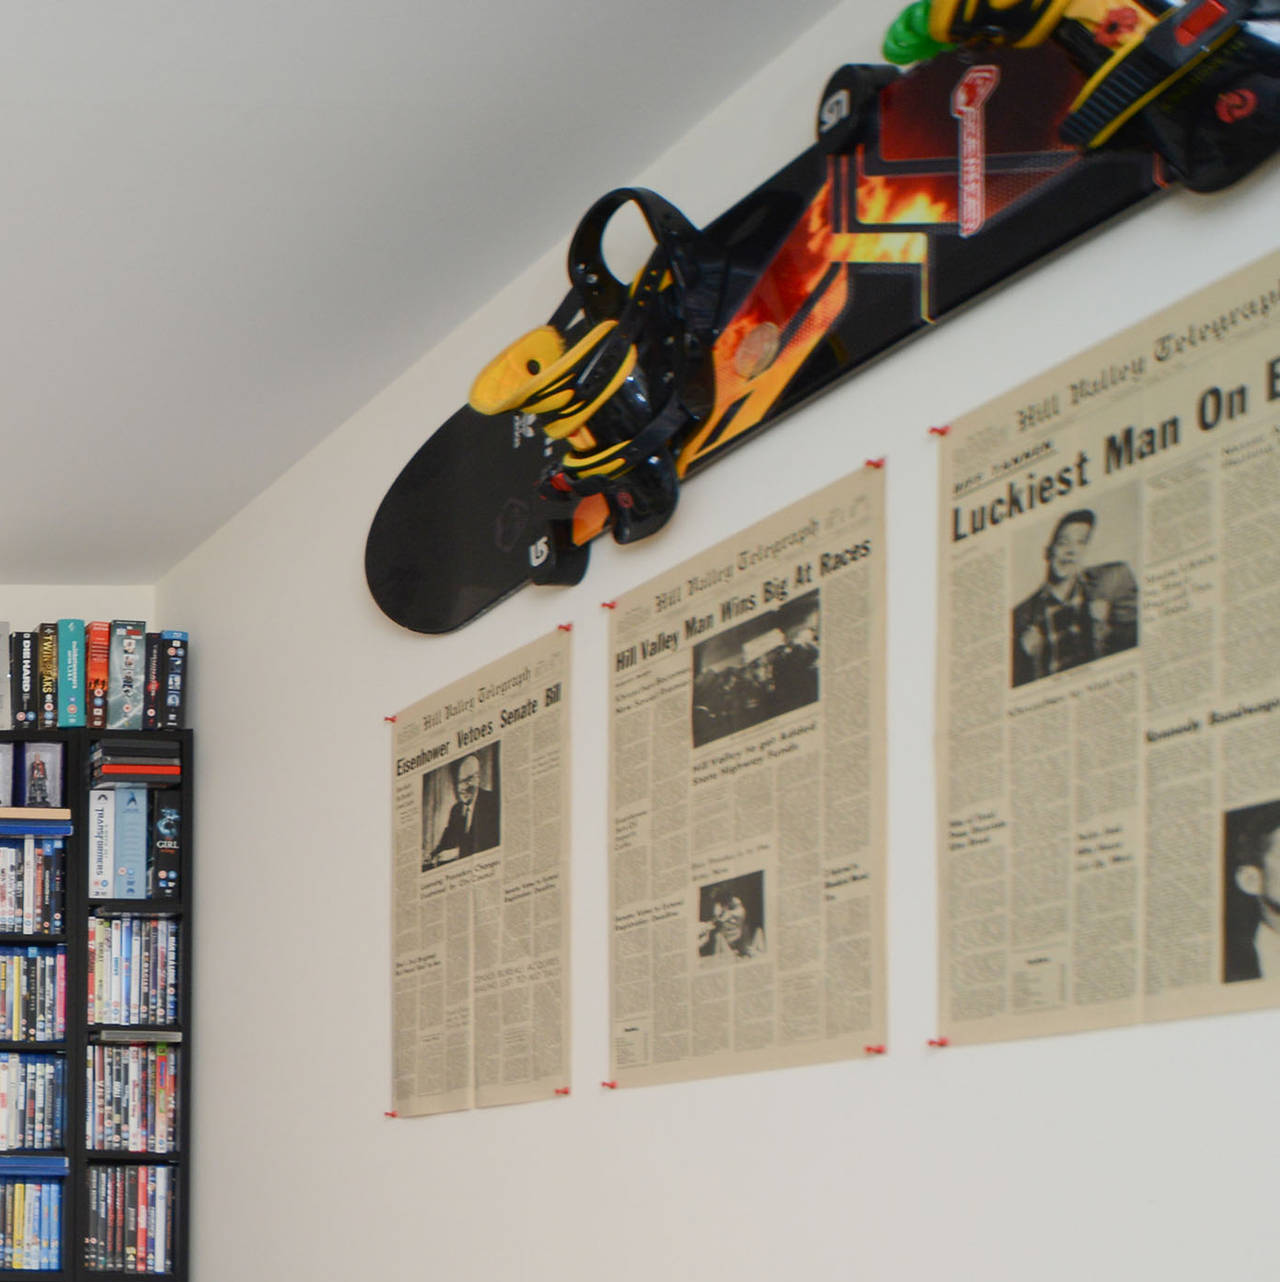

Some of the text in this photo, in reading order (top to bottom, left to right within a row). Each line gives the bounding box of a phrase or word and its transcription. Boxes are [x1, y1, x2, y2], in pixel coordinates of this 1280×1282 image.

[951, 384, 1248, 543] Luckiest Man On
[615, 538, 872, 673] Hill Valley Man Wins Big At Races
[23, 639, 31, 692] DIE HARD
[42, 635, 53, 694] TWIN PEAKS
[396, 740, 450, 776] Eisenhower
[457, 721, 494, 749] Vetoes
[500, 699, 538, 729] Senate
